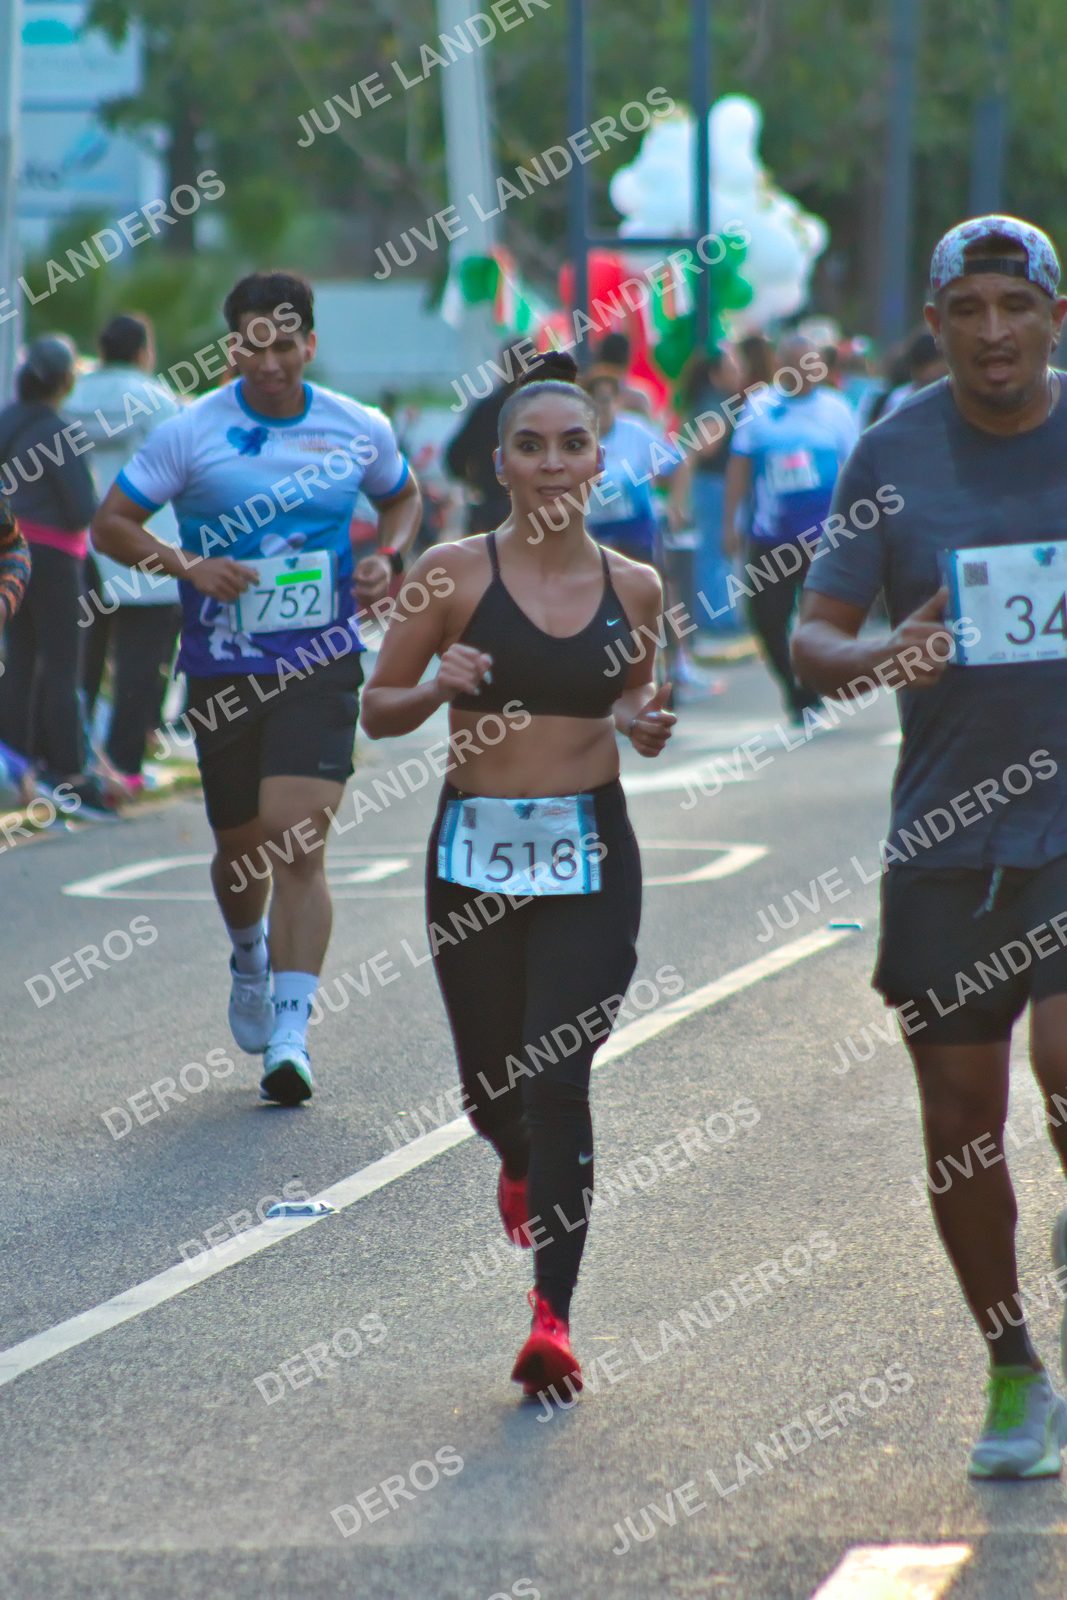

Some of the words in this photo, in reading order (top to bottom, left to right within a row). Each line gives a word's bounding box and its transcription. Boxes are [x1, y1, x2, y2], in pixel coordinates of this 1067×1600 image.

[255, 584, 321, 621] 752
[1005, 591, 1067, 645] 34
[462, 838, 578, 883] 1518
